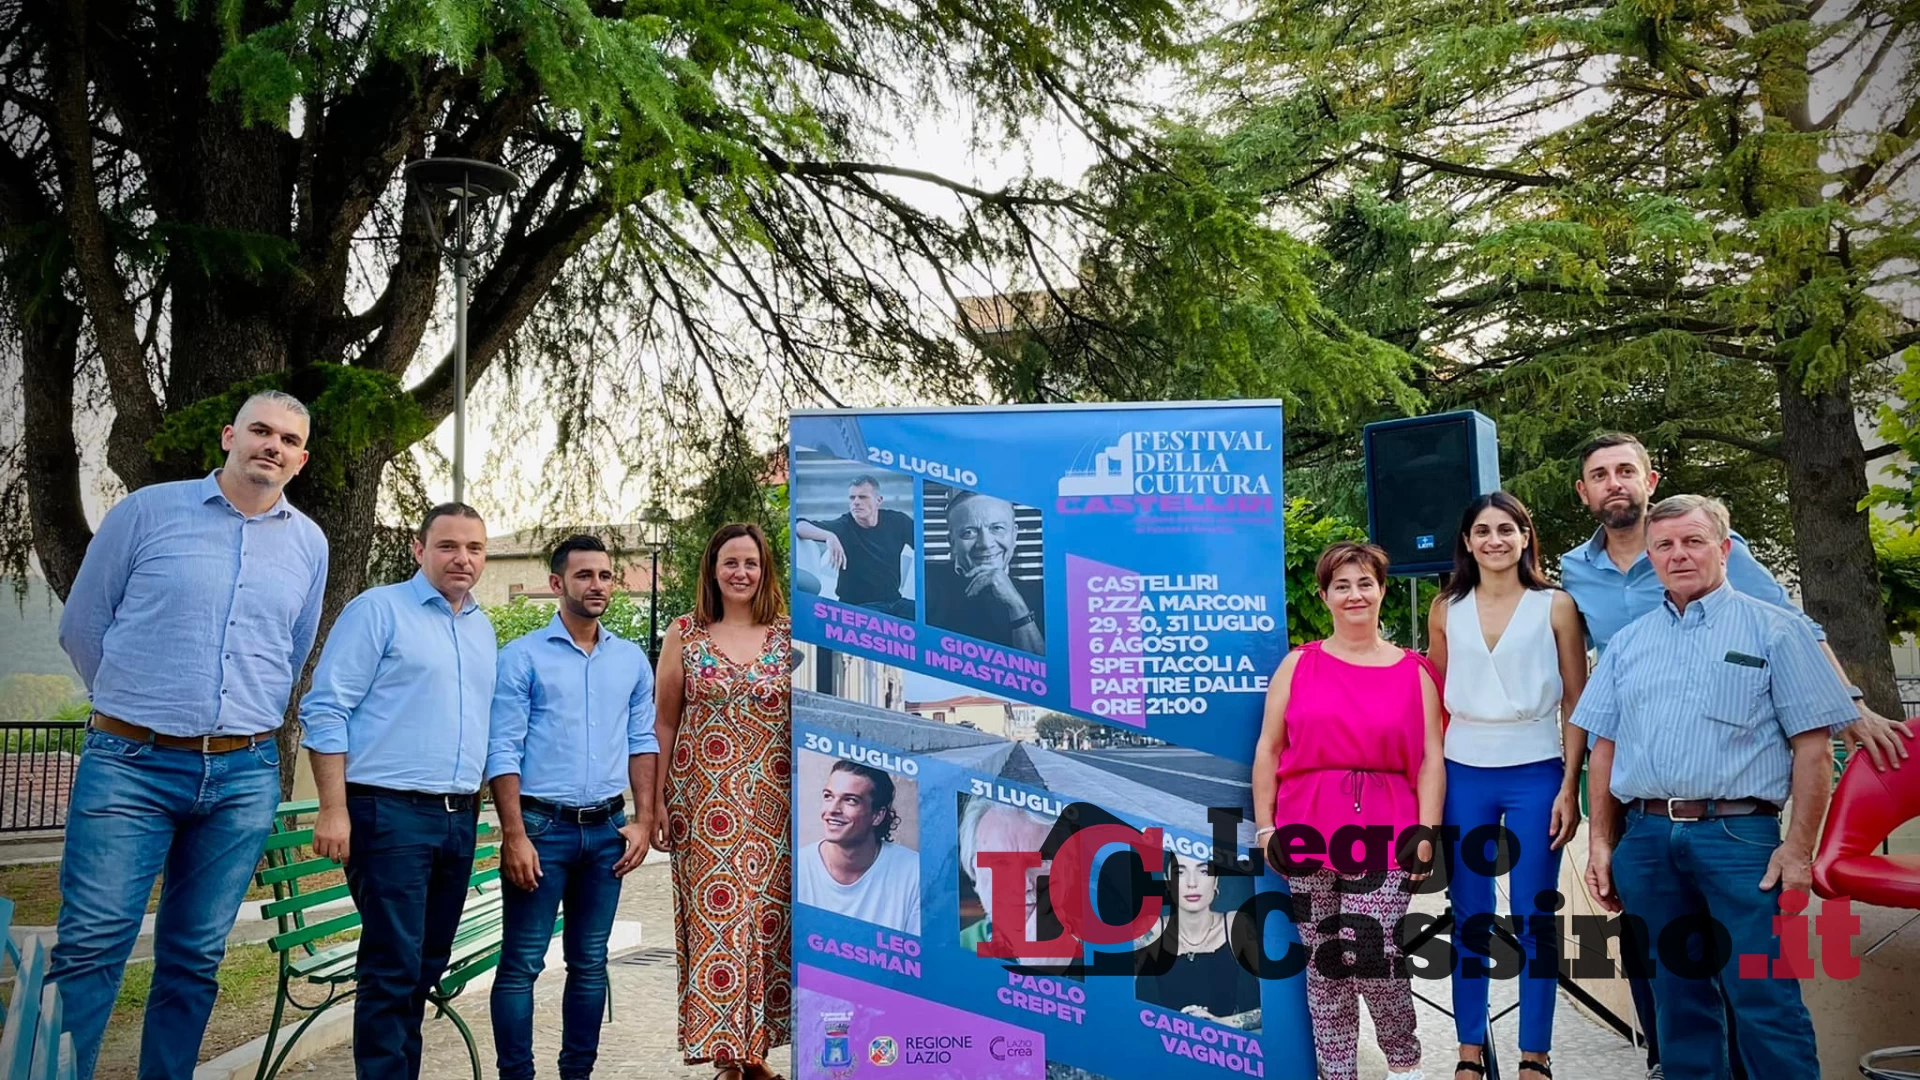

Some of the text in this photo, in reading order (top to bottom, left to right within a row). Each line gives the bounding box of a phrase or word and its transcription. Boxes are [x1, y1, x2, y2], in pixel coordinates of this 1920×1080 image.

[1134, 431, 1272, 451] FESTIVAL
[867, 447, 978, 486] 29 LUGLIO
[1134, 453, 1229, 473] DELLA
[1134, 474, 1272, 495] CULTURA
[1056, 496, 1273, 514] CASTELLIRI
[1087, 574, 1218, 592] CASTELLIRI
[1088, 595, 1266, 613] P.ZZA MARCONI
[813, 602, 916, 641] STEFANO
[1088, 614, 1275, 636] 29, 30, 31 LUGLIO
[825, 624, 916, 661] MASSINI
[1089, 635, 1209, 653] 6 AGOSTO
[940, 637, 1047, 678] GIOVANNI
[1090, 655, 1255, 674] SPETTACOLI A
[924, 650, 1047, 696] IMPASTATO
[1091, 676, 1268, 695] PARTIRE DALLE
[1091, 697, 1208, 716] ORE 21:00
[805, 732, 919, 776] 30 LUGLIO
[970, 779, 1080, 820] 31 LUGLIO
[1161, 830, 1255, 873] AGOSTO
[876, 931, 921, 957] LEO
[807, 934, 921, 978] GASSMAN
[1008, 971, 1086, 1004] PAOLO
[997, 987, 1086, 1025] CREPET
[906, 1036, 973, 1049] REGIONE
[1006, 1040, 1033, 1048] LAZIO
[1139, 1009, 1264, 1058] CARLOTTA
[906, 1051, 952, 1064] LAZIO
[1007, 1048, 1033, 1057] crea
[1160, 1034, 1264, 1078] VAGNOLI
